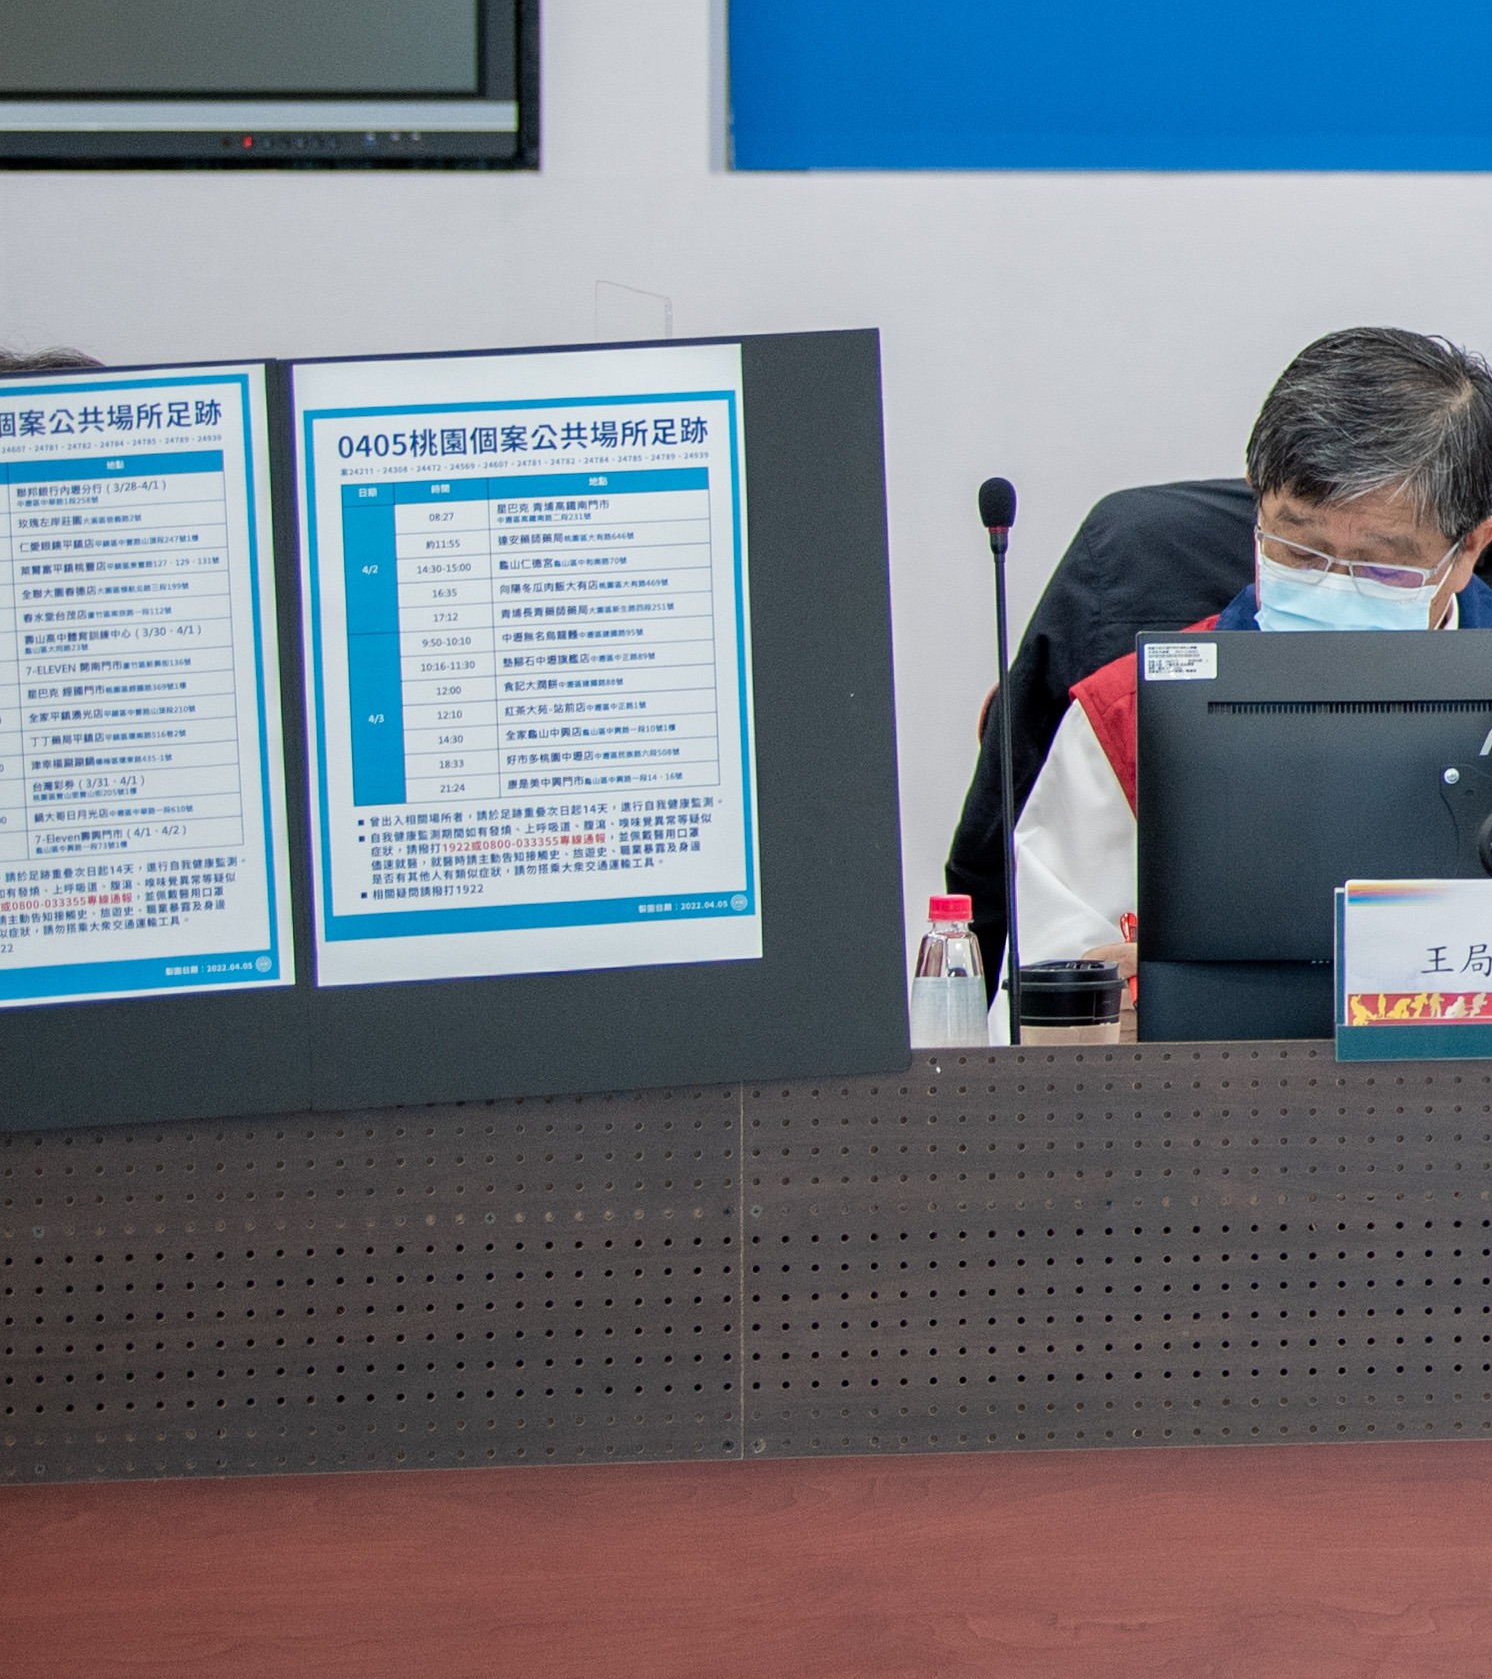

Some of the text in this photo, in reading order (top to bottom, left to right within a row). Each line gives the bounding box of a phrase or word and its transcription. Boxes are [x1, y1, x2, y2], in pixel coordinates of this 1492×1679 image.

[338, 416, 709, 459] 0405桃園個案公共場所足跡
[588, 476, 608, 487] 地點
[358, 486, 378, 498] 日期
[431, 484, 450, 495] 時間
[429, 512, 454, 522] 08:27
[362, 564, 378, 575] 4/2
[417, 562, 471, 574] 14:30-15:00
[432, 588, 457, 598] 16:35
[433, 613, 458, 622] 17:12
[422, 636, 471, 647] 9:50-10:10
[420, 660, 475, 672] 10:16-11:30
[436, 685, 461, 695] 12:00
[368, 713, 385, 724] 4/3
[437, 710, 462, 720] 12:10
[438, 734, 463, 744] 14:30
[439, 759, 464, 769] 18:33
[440, 783, 465, 793] 21:24
